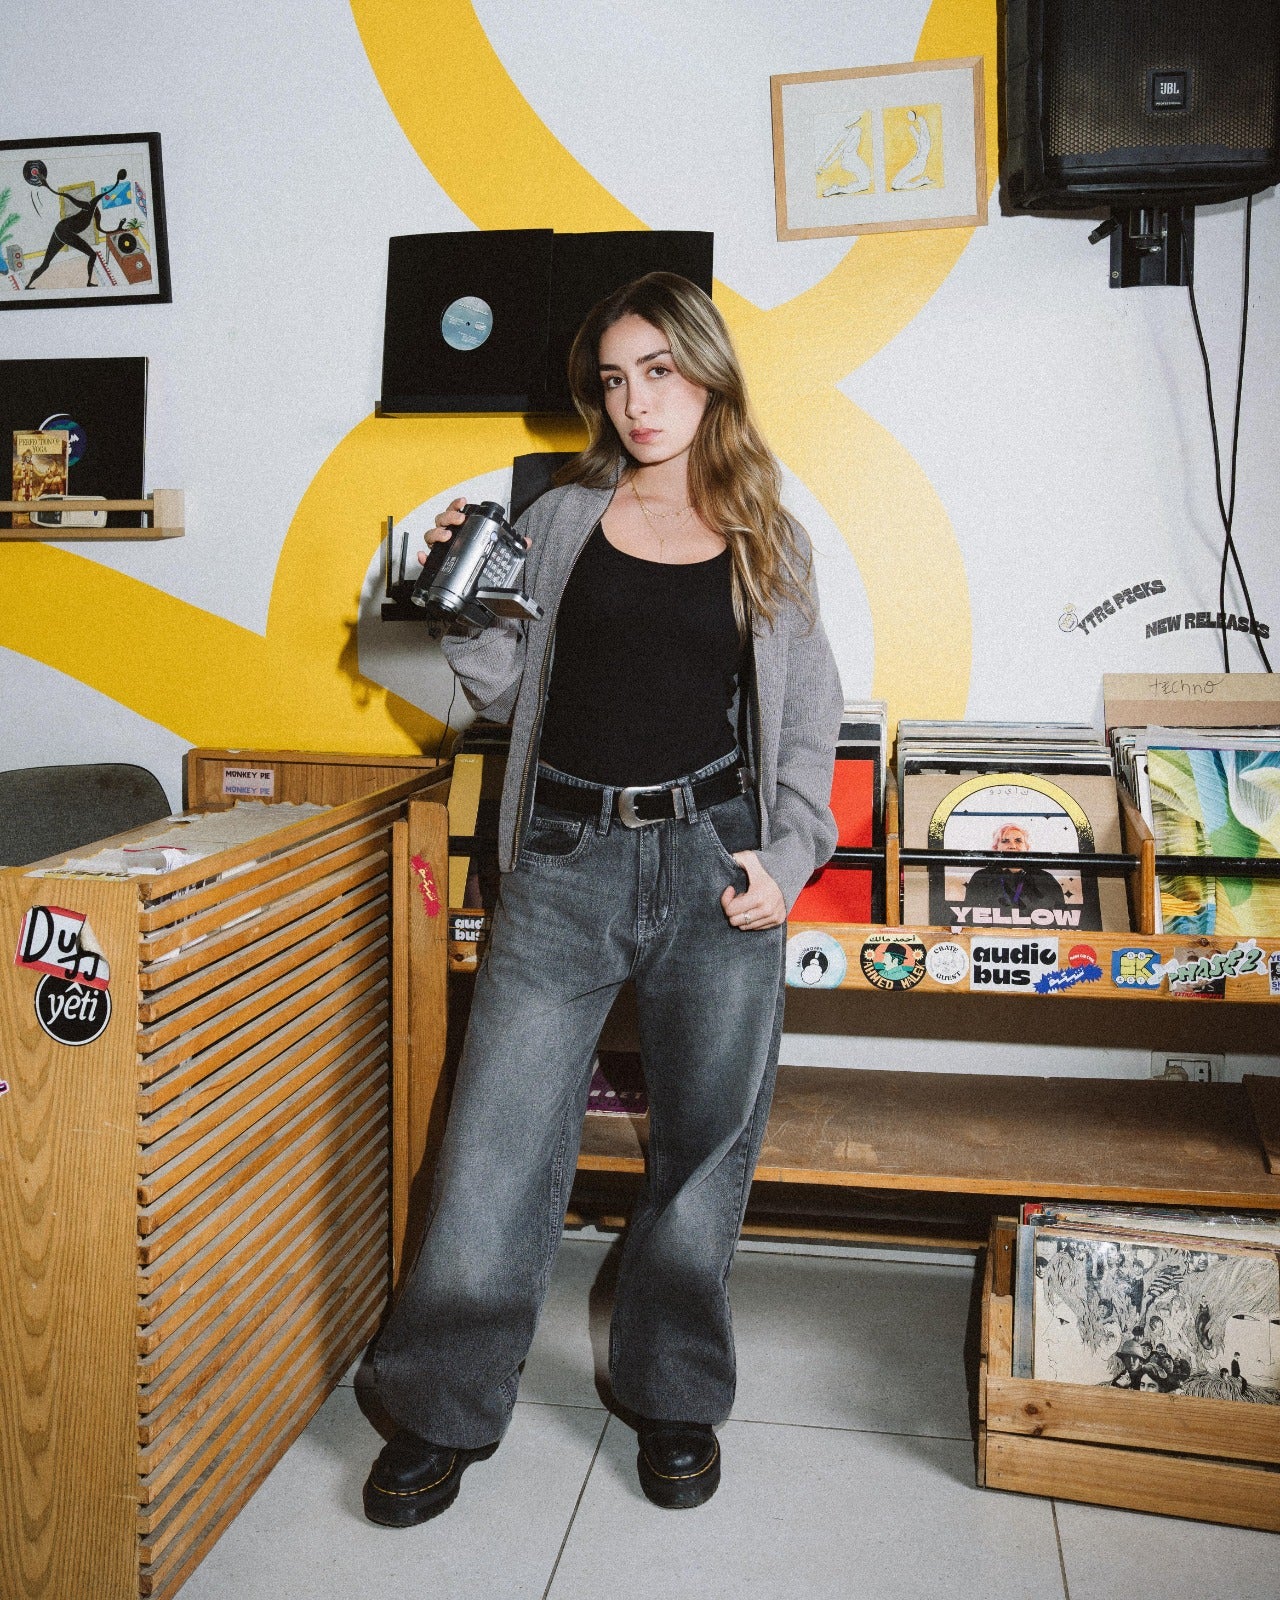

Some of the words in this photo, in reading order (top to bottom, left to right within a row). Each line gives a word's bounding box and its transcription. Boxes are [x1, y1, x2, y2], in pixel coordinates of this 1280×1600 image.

[1160, 82, 1180, 95] JBL
[1145, 614, 1181, 639] NEW
[1150, 676, 1226, 696] techno
[225, 770, 257, 778] MONKEY
[225, 786, 257, 794] MONKEY
[949, 906, 1081, 926] YELLOW
[973, 942, 1057, 965] audio
[1239, 948, 1263, 973] 2
[863, 960, 894, 990] AHMED
[900, 960, 926, 989] MALEK
[973, 964, 1031, 986] bus
[46, 981, 100, 1026] yêti
